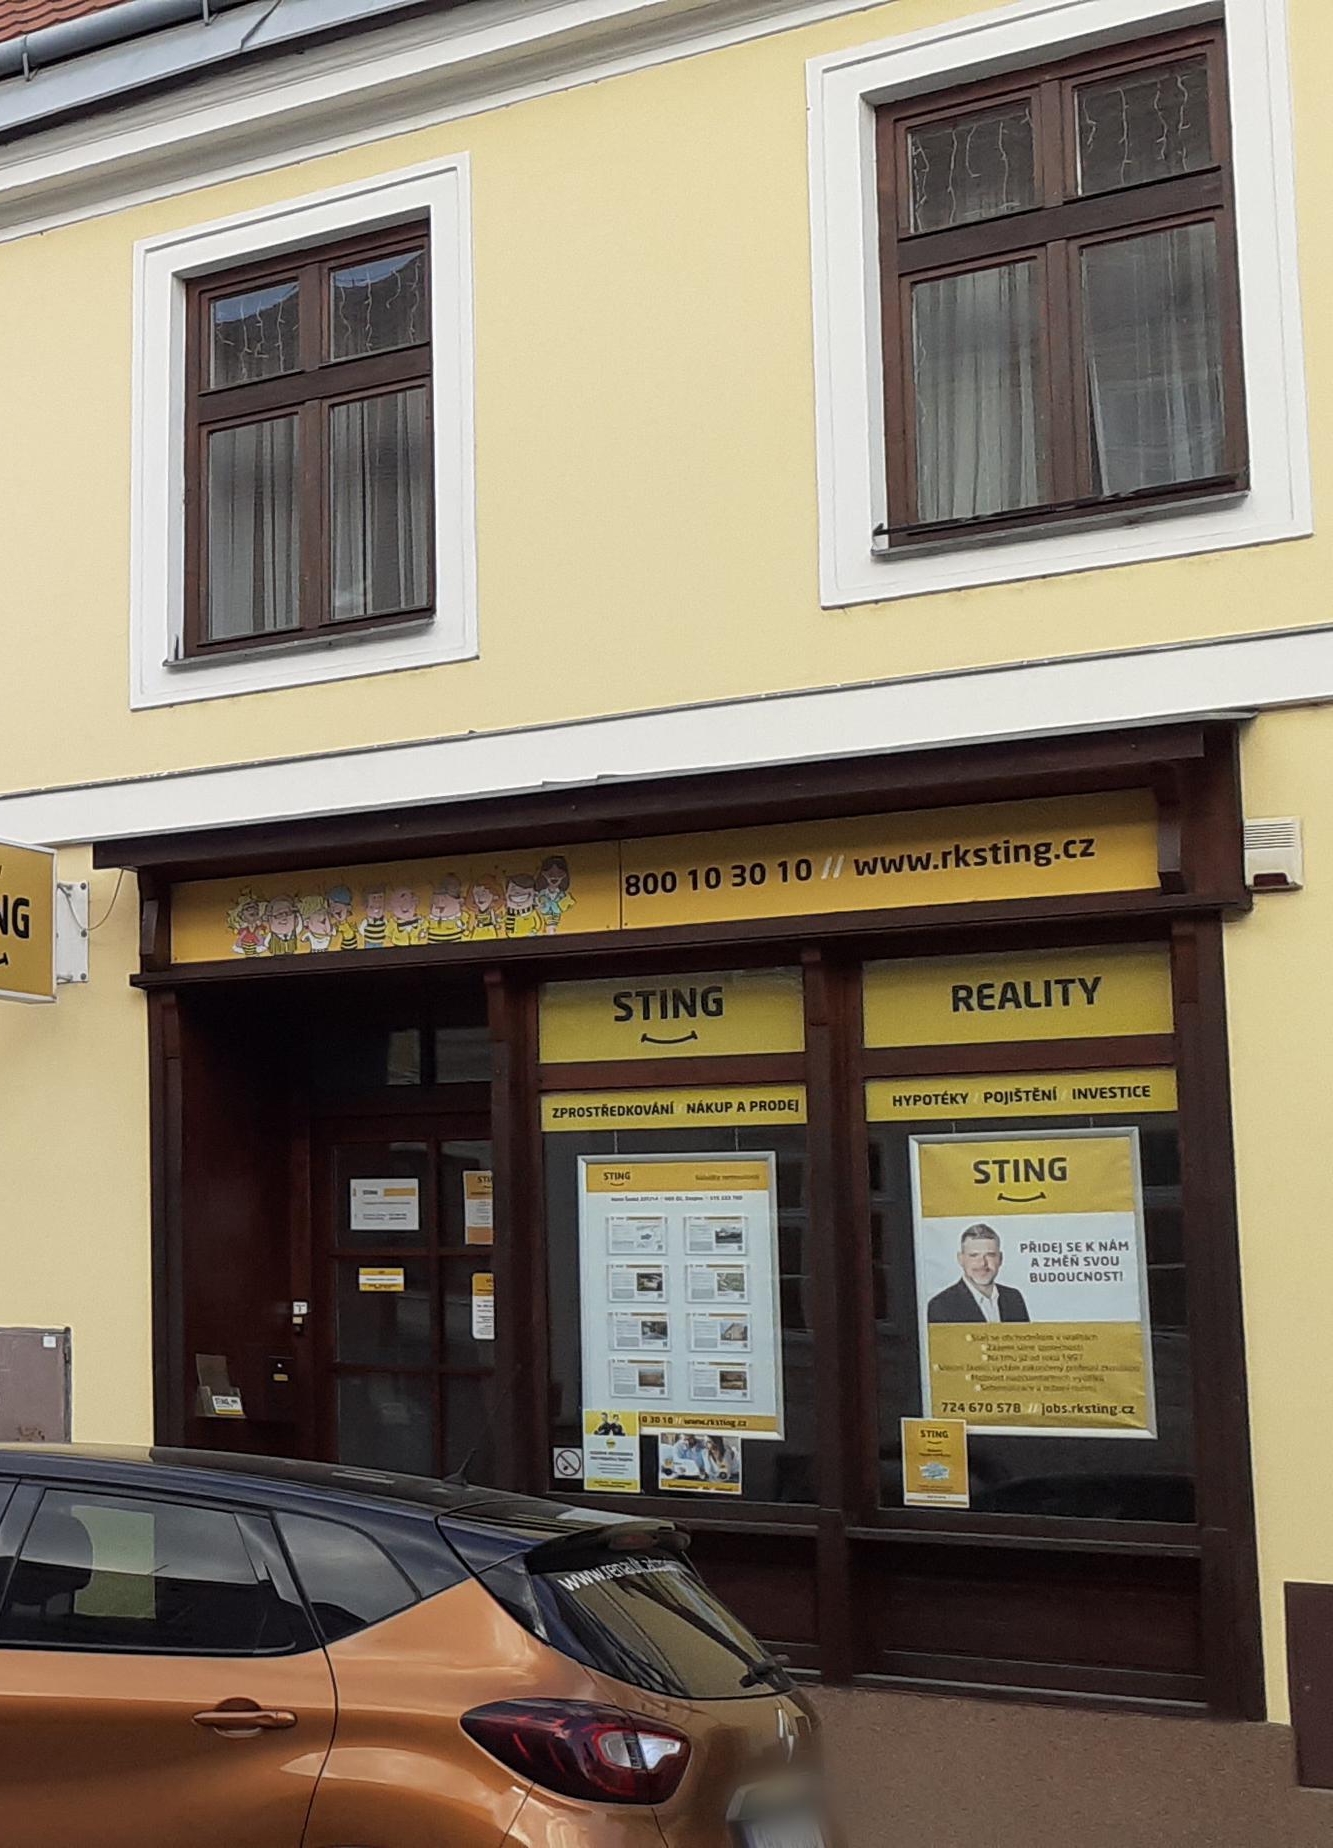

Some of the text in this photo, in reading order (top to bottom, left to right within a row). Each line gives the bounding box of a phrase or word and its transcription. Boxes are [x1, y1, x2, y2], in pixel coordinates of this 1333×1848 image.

[625, 871, 677, 896] 800
[687, 867, 721, 891] 10
[731, 863, 766, 887] 30
[777, 859, 812, 883] 10
[853, 838, 1095, 876] www.rksting.cz
[952, 976, 1102, 1013] REALITY
[613, 986, 724, 1022] STING
[892, 1085, 1150, 1107] HYPOTÉKY POJIŠTĚNÍ INVESTICE
[552, 1099, 799, 1119] ZPROSTŘEDKOVÁNÍ NÁKUP A PRODEJ
[604, 1172, 631, 1181] STING
[973, 1157, 1068, 1184] STING
[1020, 1239, 1129, 1254] PŘIDEJ SE K NÁM
[1031, 1254, 1120, 1267] A ZMĚŇ SVOU
[1029, 1271, 1123, 1283] BUDOUCNOST!
[942, 1402, 1136, 1416] 724 670 578 jobs.rksting.cz
[920, 1430, 949, 1438] STING
